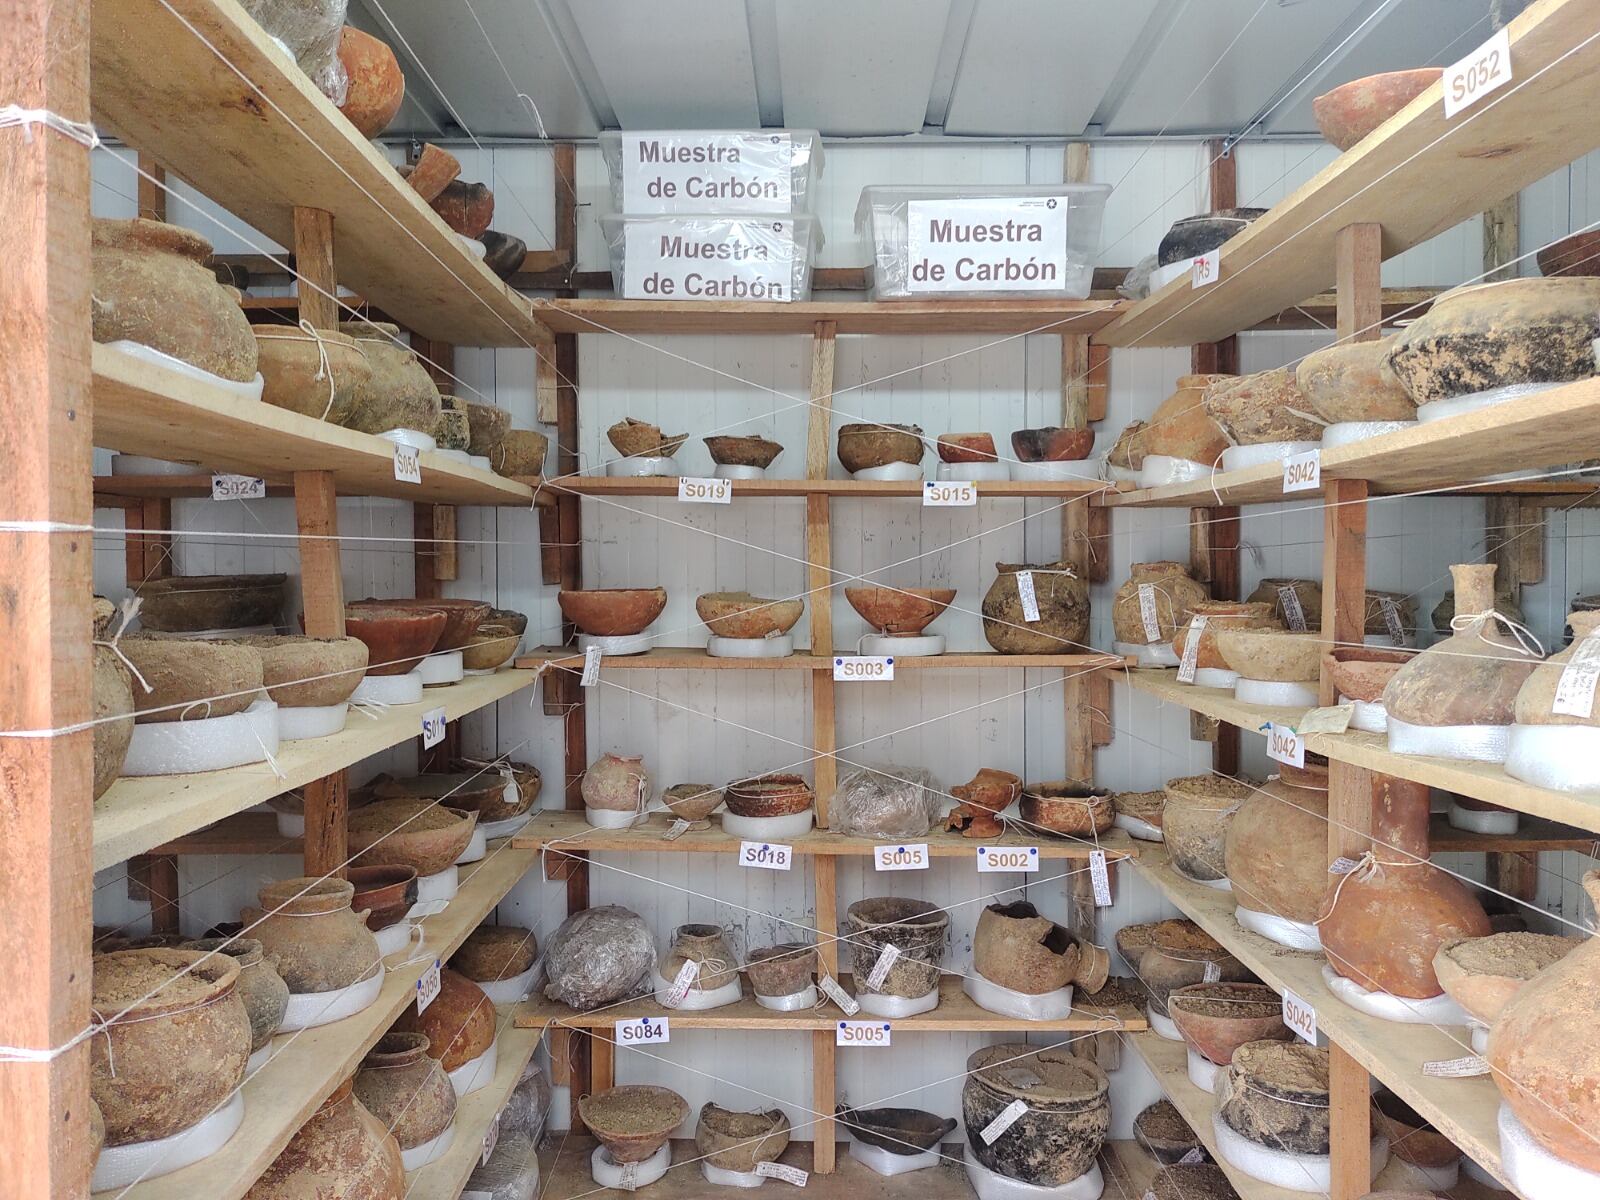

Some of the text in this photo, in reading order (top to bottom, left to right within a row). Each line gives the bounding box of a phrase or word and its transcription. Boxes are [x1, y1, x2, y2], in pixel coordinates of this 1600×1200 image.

[1452, 49, 1501, 103] S052
[639, 141, 741, 163] Muestra
[647, 176, 778, 198] de Carbón
[930, 219, 1043, 243] Muestra
[660, 235, 769, 260] Muestra
[912, 256, 1057, 282] de Carbón
[643, 272, 783, 299] de Carbón
[397, 454, 419, 476] S054
[1287, 461, 1315, 485] S042
[219, 481, 259, 495] S024
[685, 484, 726, 499] S019
[929, 486, 971, 501] S015
[843, 662, 884, 676] S003
[1272, 733, 1297, 759] S042
[745, 849, 786, 865] S018
[881, 850, 922, 866] S005
[988, 853, 1029, 868] S002
[1286, 1000, 1313, 1035] S042
[622, 1024, 664, 1040] S084
[843, 1026, 884, 1041] S005
